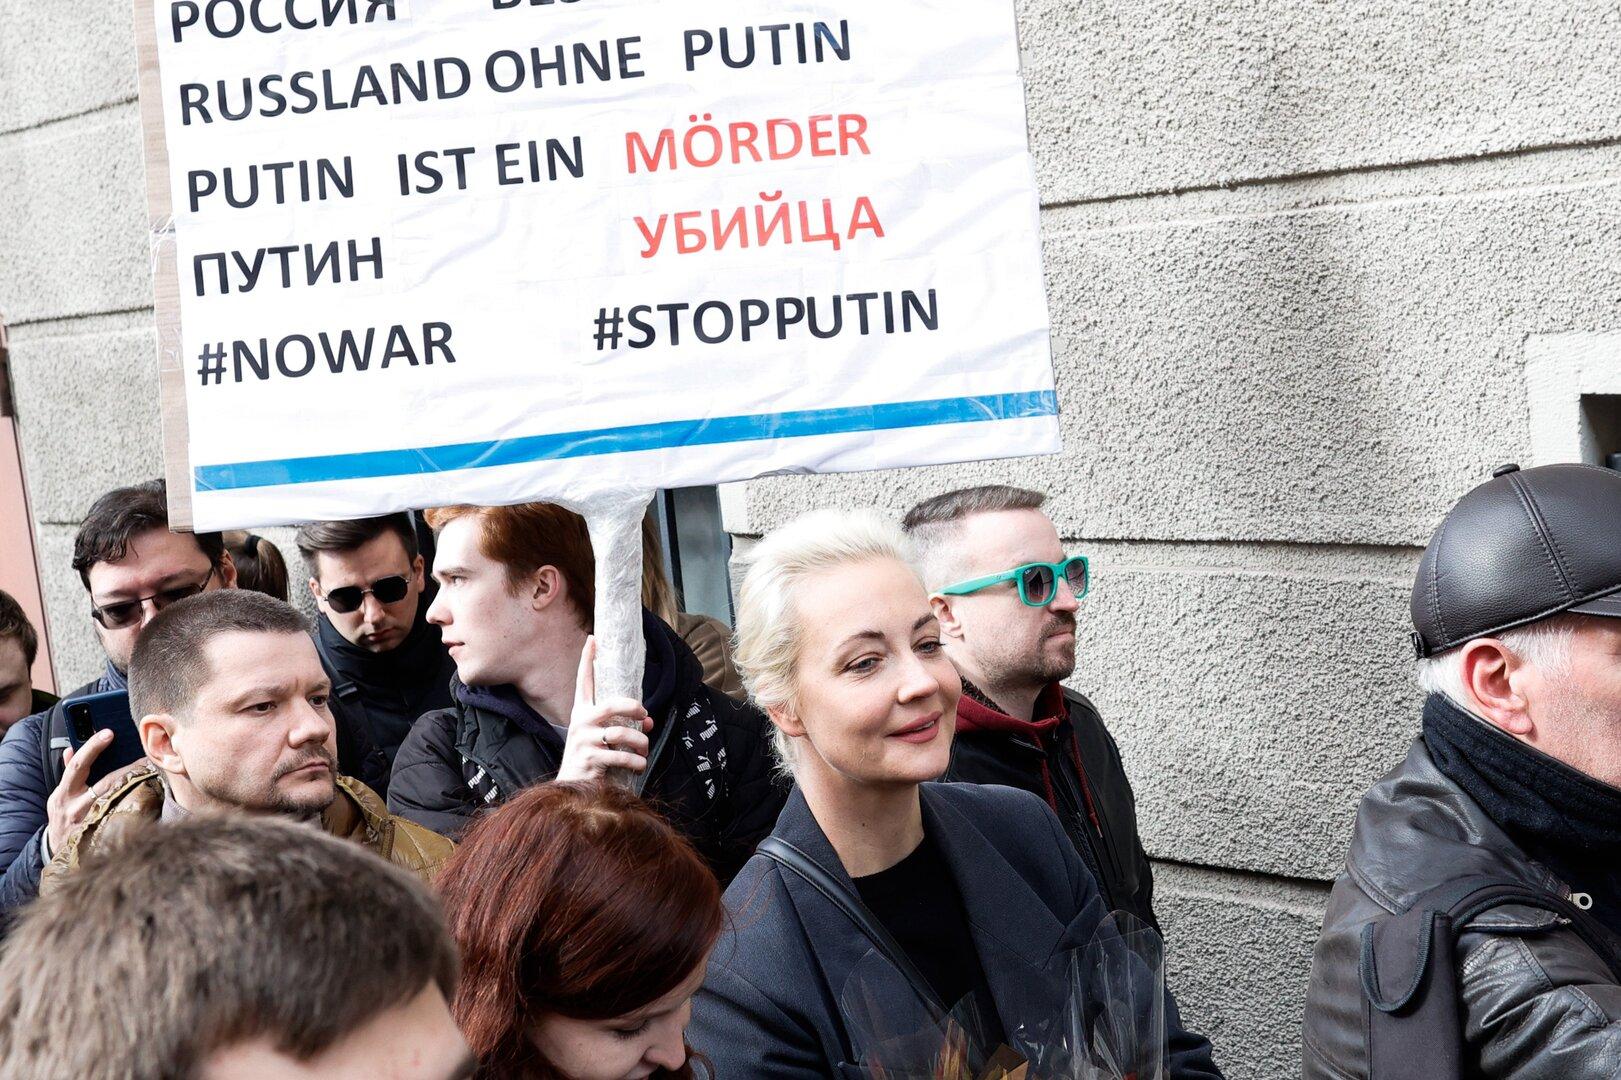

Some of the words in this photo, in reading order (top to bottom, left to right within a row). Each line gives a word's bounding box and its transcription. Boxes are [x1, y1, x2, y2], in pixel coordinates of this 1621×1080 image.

[179, 57, 471, 126] RUSSLAND
[485, 35, 645, 93] OHNE
[683, 19, 851, 72] PUTIN
[187, 156, 354, 213] PUTIN
[397, 146, 476, 196] IST
[495, 135, 584, 186] EIN
[625, 112, 871, 174] MÖRDER
[193, 236, 384, 297] ПУТИН
[634, 190, 885, 259] УБИЙЦА
[197, 321, 457, 386] #NOWAR
[593, 288, 939, 351] #STOPPUTIN
